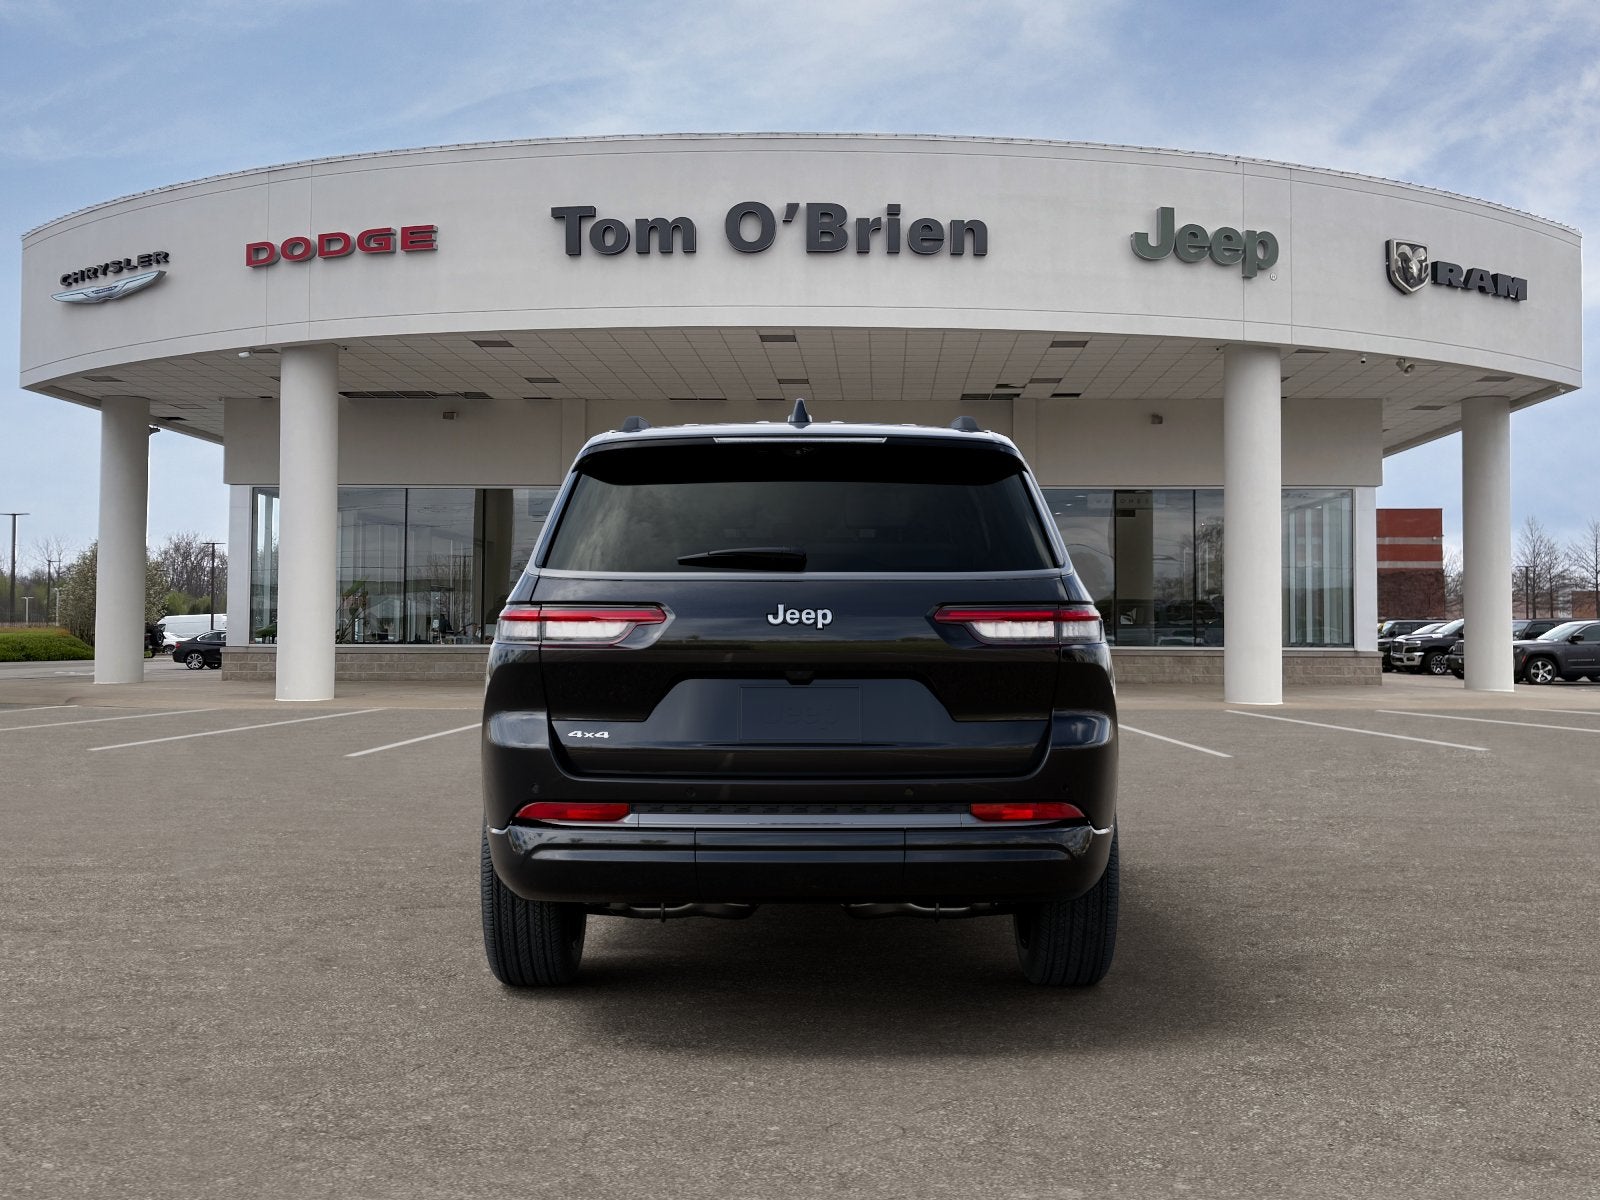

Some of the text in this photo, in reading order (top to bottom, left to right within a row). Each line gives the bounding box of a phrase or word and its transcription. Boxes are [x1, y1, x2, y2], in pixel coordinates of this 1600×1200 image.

[245, 225, 438, 269] DODGE
[551, 202, 989, 256] Tom O'Brien
[1130, 207, 1279, 278] Jeep
[60, 250, 170, 286] CHRYSLER
[1431, 261, 1528, 301] RAM
[767, 604, 833, 629] Jeep
[567, 729, 611, 740] 4x4
